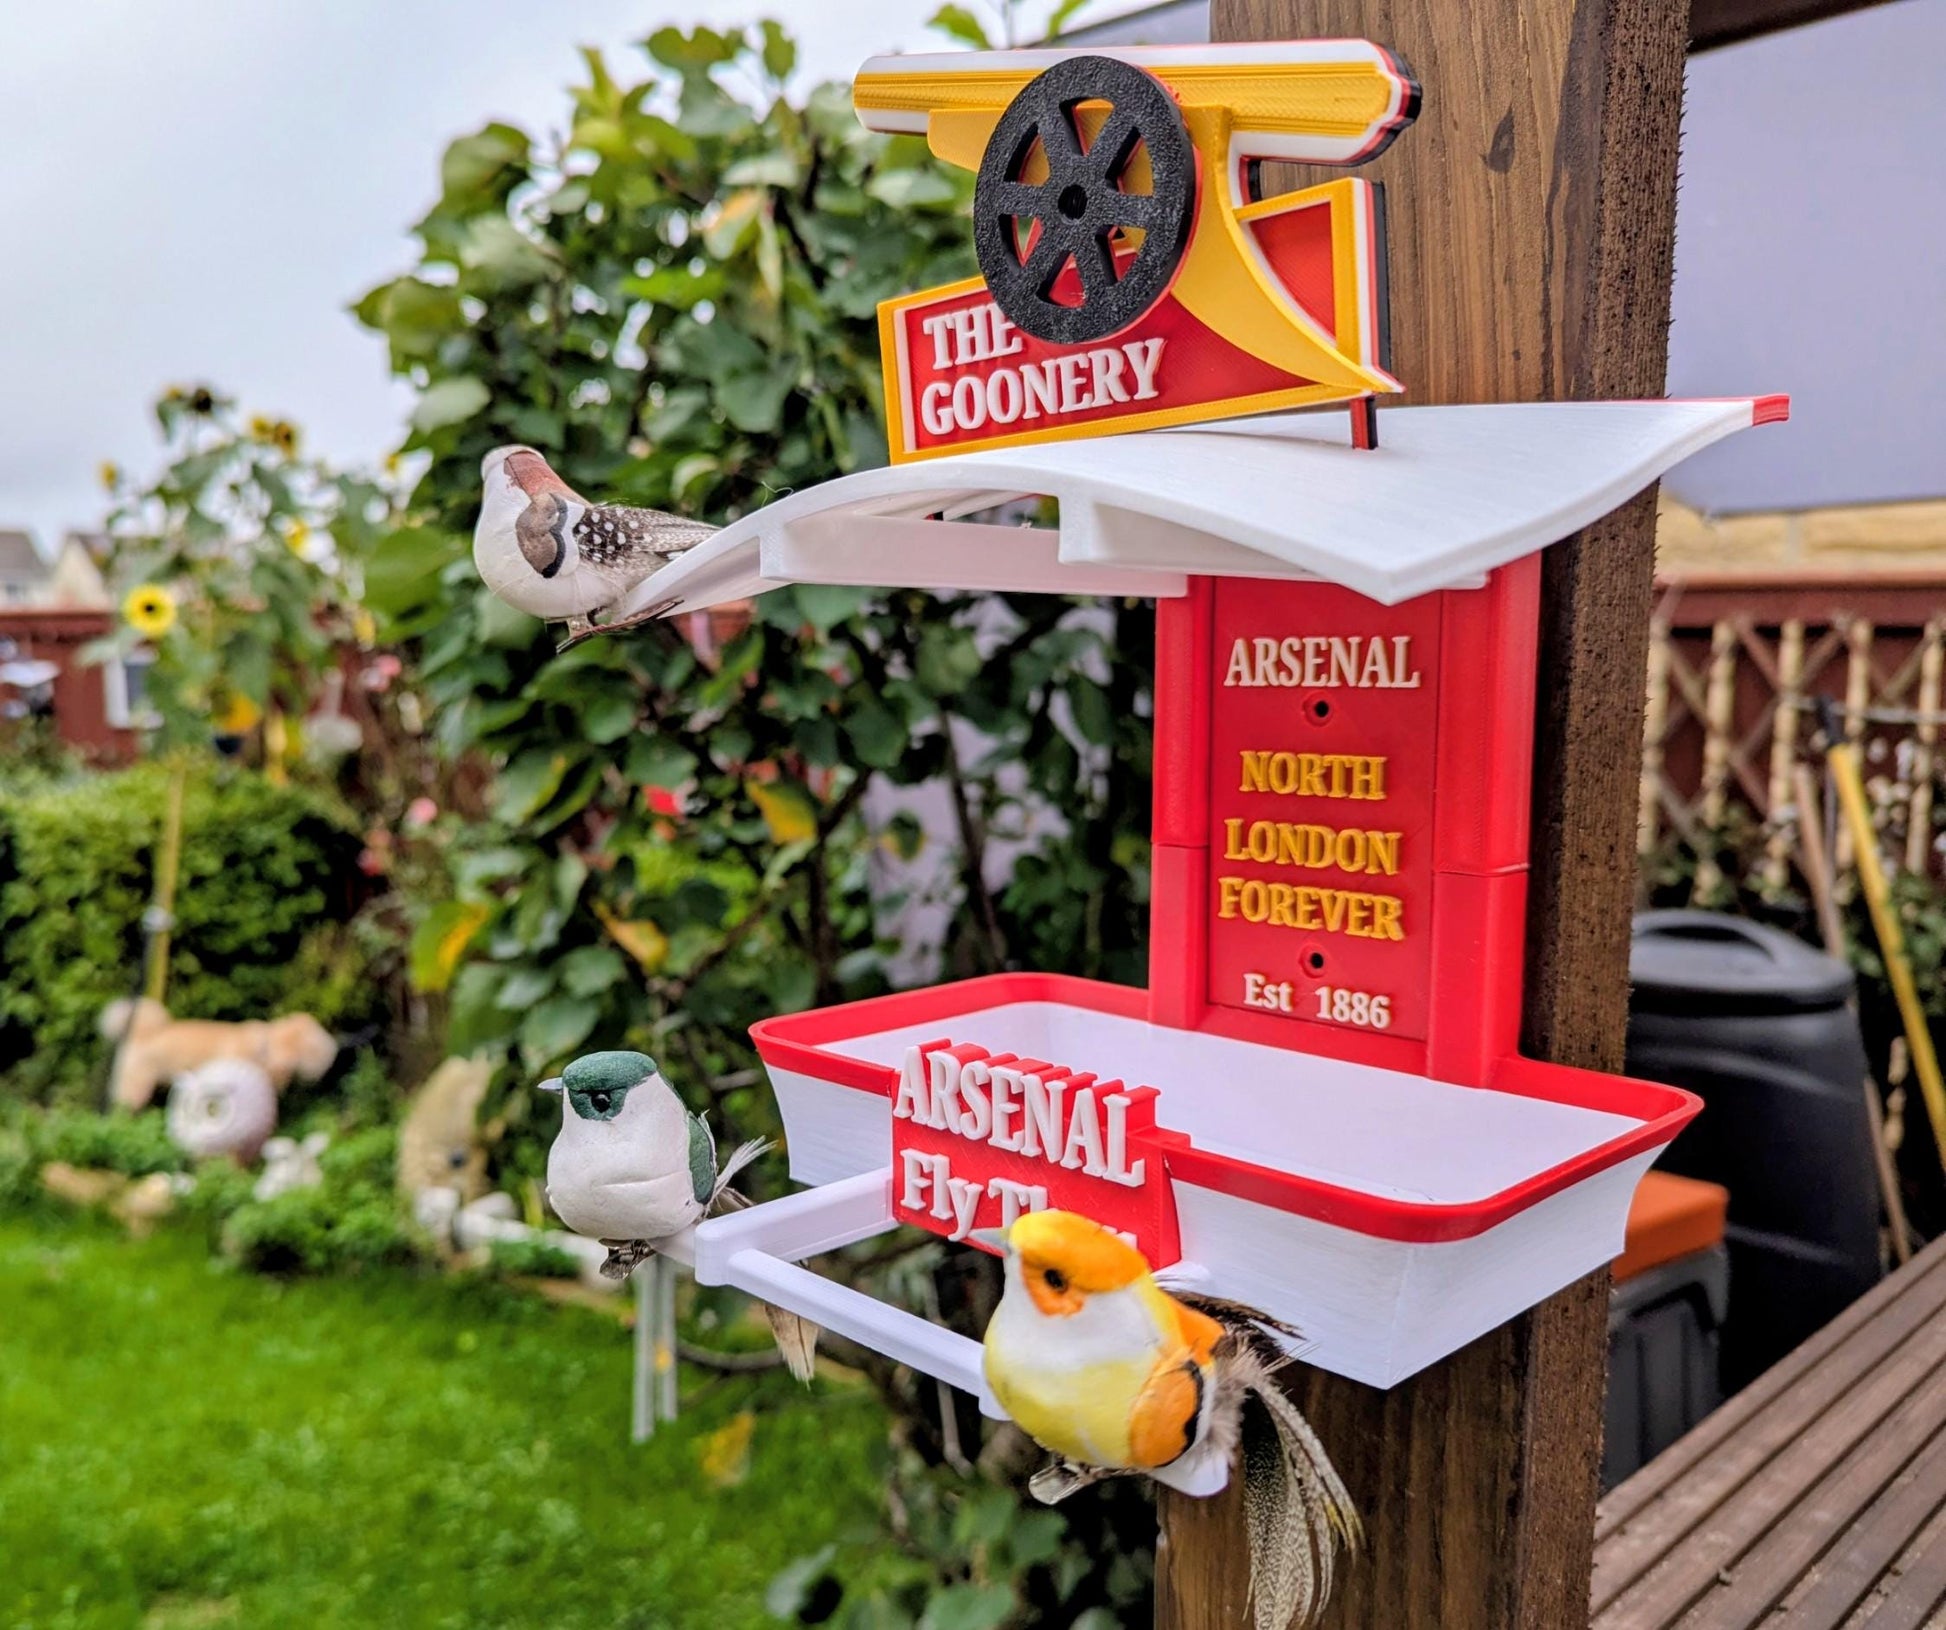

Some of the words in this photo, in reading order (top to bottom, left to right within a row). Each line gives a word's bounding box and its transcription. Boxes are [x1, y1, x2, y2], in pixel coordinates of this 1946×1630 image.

[922, 303, 1023, 370] THE
[920, 337, 1167, 436] GOONERY
[1223, 636, 1421, 688] ARSENAL
[1238, 750, 1388, 801] NORTH
[1223, 818, 1403, 876] LONDON
[1217, 877, 1405, 941] FOREVER
[1242, 973, 1294, 1012] Est
[1314, 985, 1391, 1029] 1886
[892, 1045, 1146, 1188] ARSENAL
[899, 1148, 985, 1242] Fly
